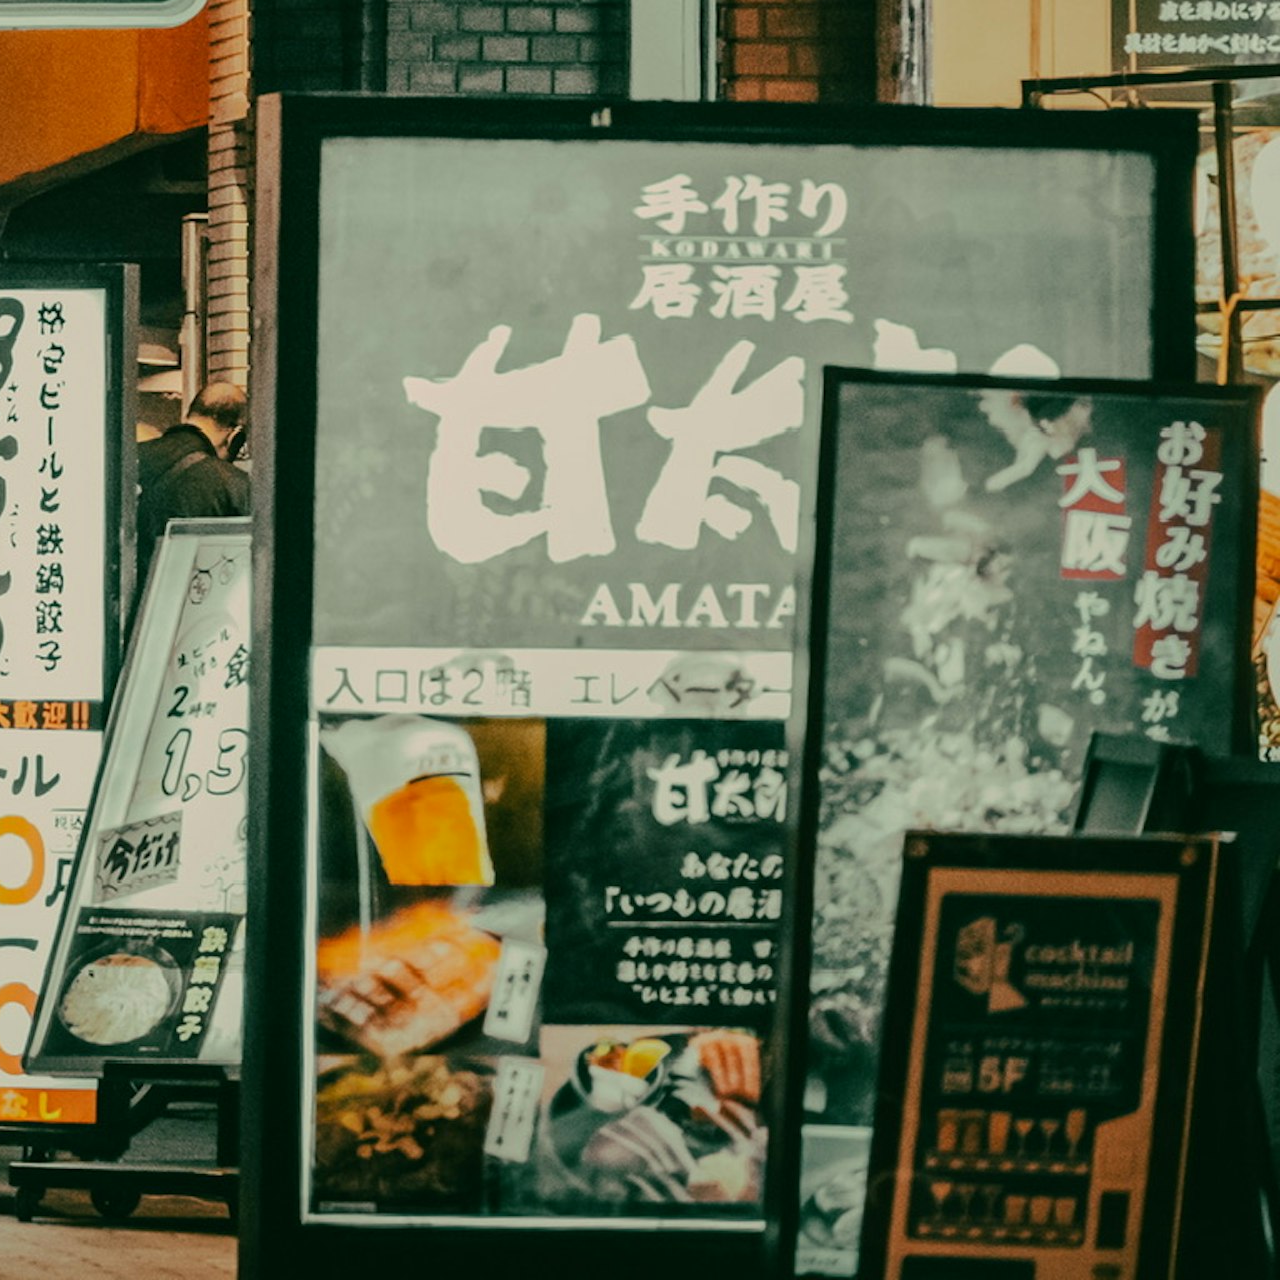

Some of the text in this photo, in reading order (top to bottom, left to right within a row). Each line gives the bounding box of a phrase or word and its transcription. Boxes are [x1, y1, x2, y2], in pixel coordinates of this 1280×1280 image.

[633, 173, 849, 237] 手作り
[627, 263, 855, 324] 居酒屋
[1133, 420, 1224, 742] お好み焼きが
